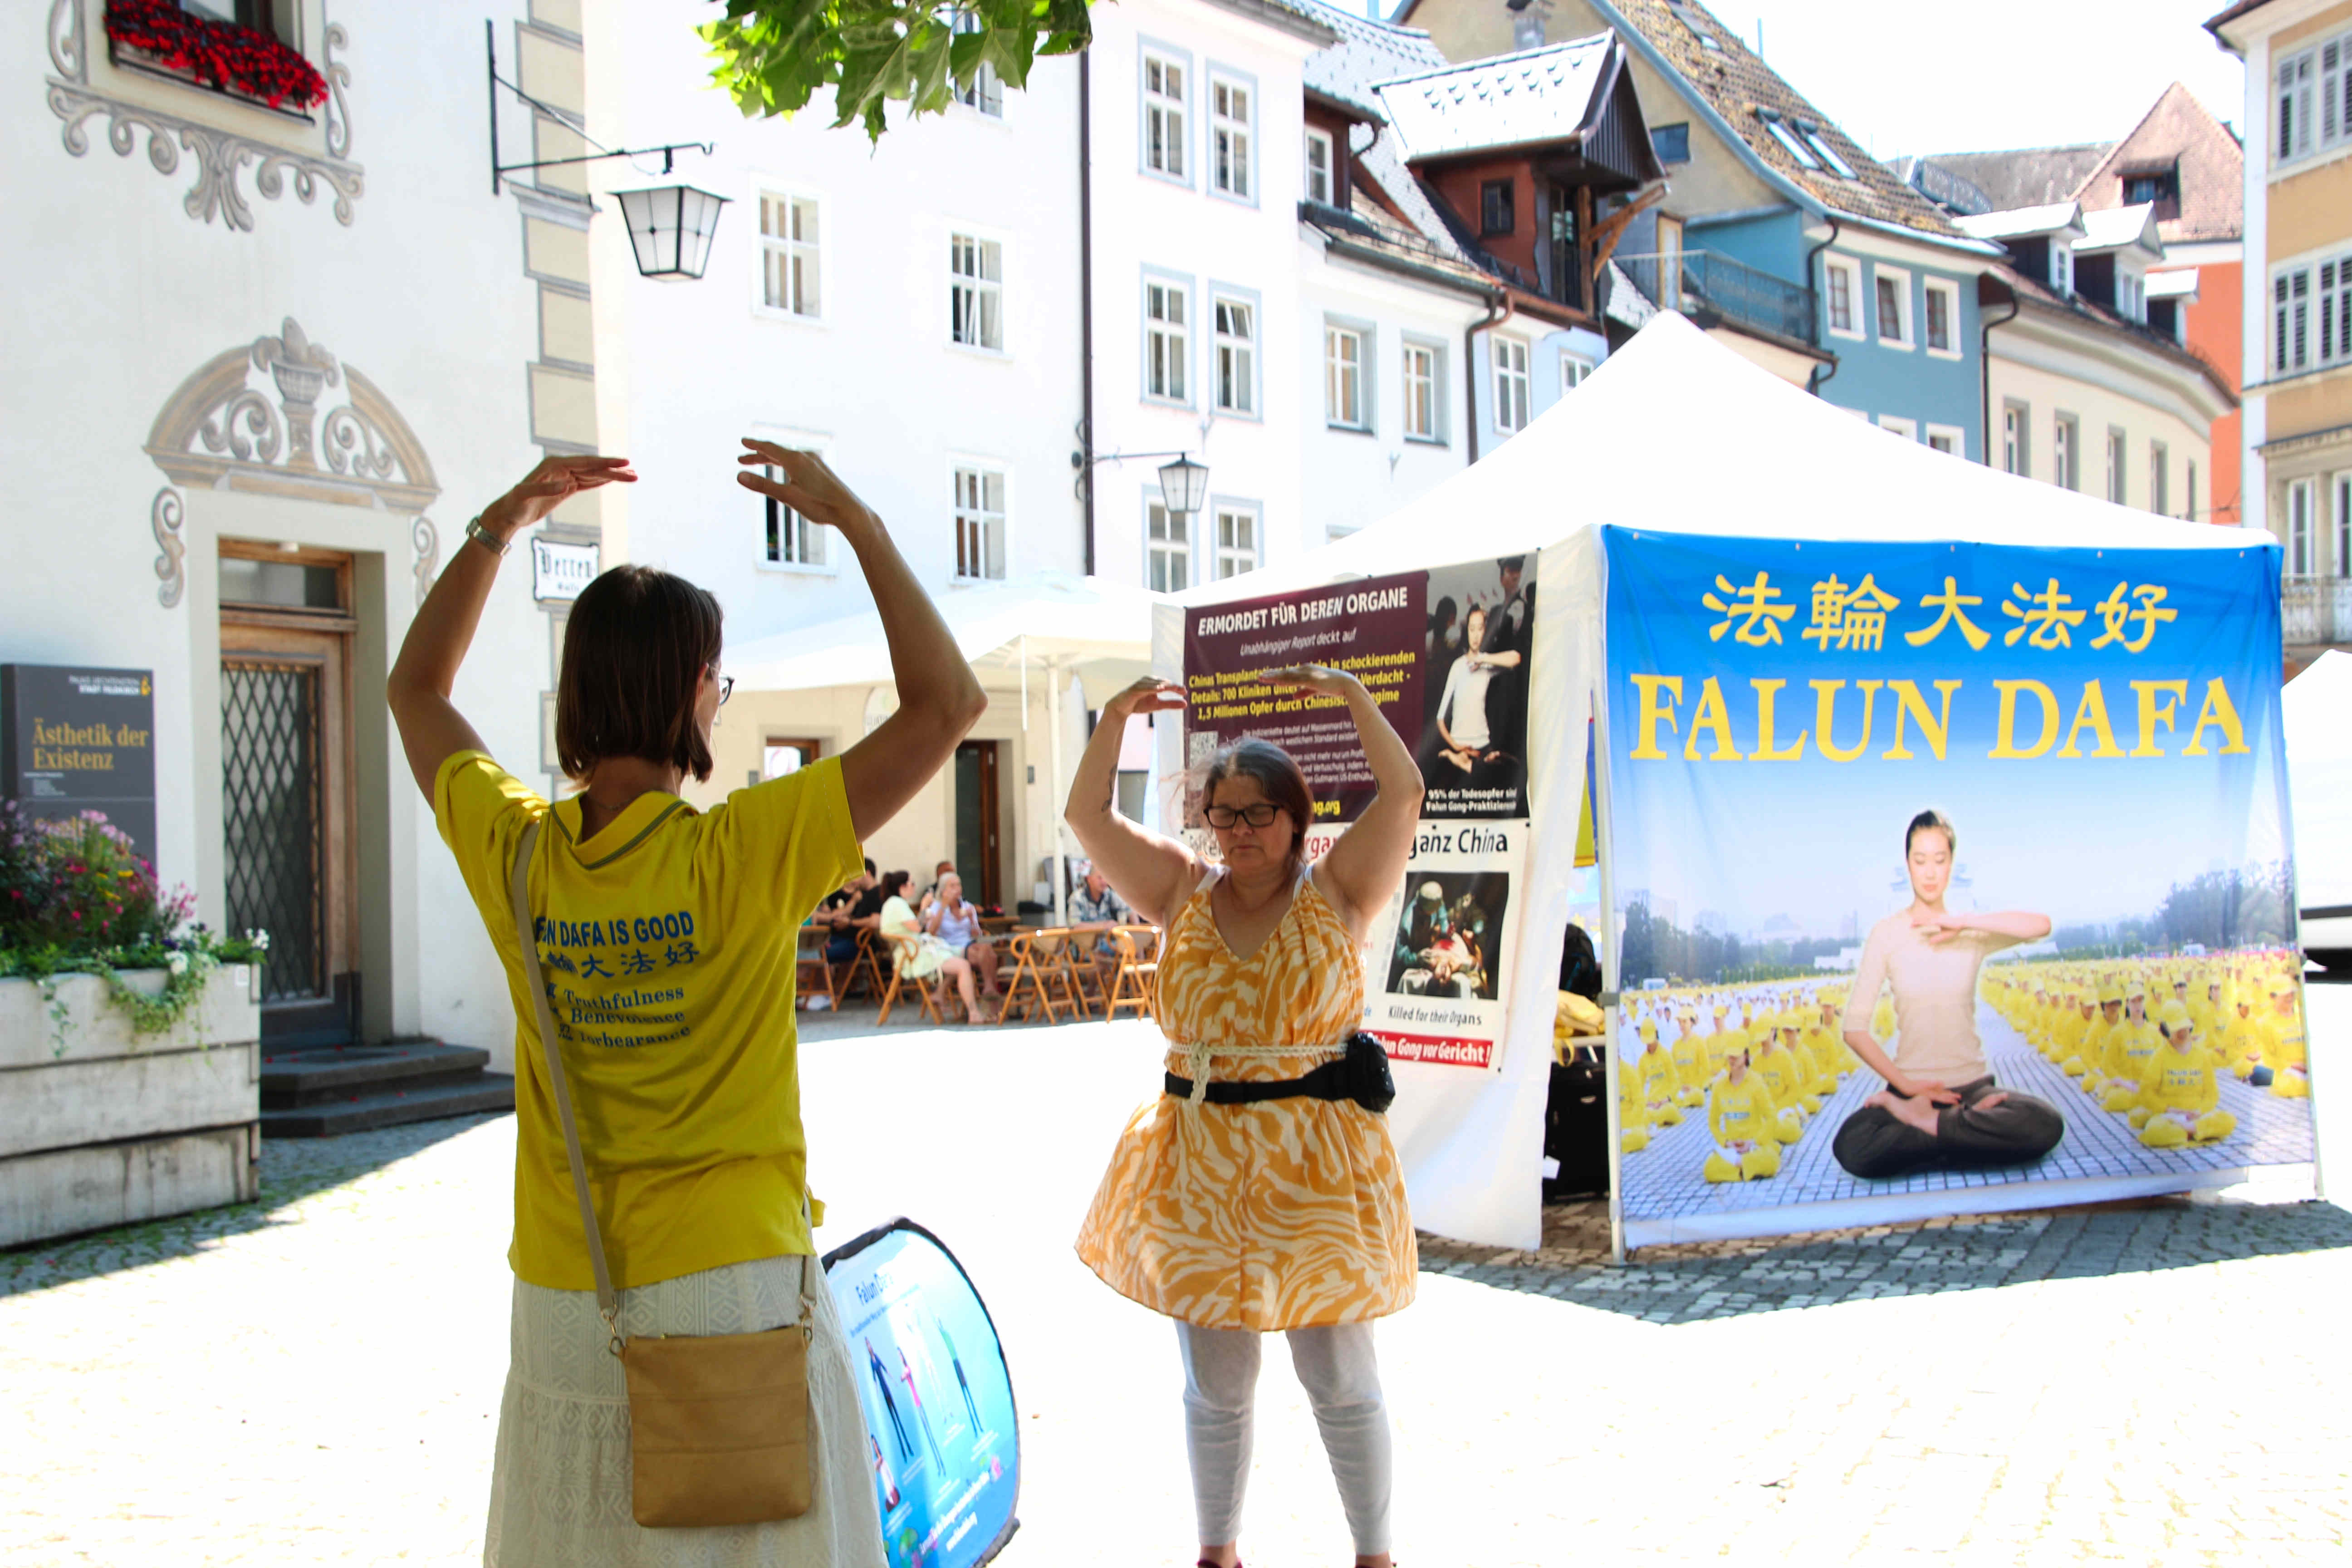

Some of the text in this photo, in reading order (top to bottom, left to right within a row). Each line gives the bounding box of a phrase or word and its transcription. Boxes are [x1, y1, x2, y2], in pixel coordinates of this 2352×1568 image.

[1198, 587, 1407, 636] ERMORDET FÜR DEREN ORGANE
[1702, 571, 2178, 653] 法輪大法好
[1317, 630, 1340, 646] deckt
[1342, 627, 1357, 642] auf
[1341, 650, 1415, 671] schockierenden
[1222, 687, 1237, 701] 700
[1238, 684, 1272, 699] Kliniken
[1213, 704, 1248, 718] Millionen
[1250, 699, 1274, 717] Opfer
[1630, 673, 2251, 761] FALUN DAFA
[32, 717, 149, 748] Ästhetik der
[33, 747, 114, 770] Existenz
[1428, 789, 1447, 800] 95%
[1448, 788, 1460, 799] der
[1461, 787, 1504, 800] Todesopfer
[1426, 800, 1447, 812] Falun
[1458, 827, 1508, 853] China
[559, 921, 606, 947] DAFA
[608, 919, 630, 946] IS
[634, 911, 694, 942] GOOD
[564, 986, 684, 1010] Truthfulness
[1388, 1005, 1414, 1021] Killed
[1415, 1007, 1429, 1022] for
[1430, 1009, 1449, 1023] their
[1449, 1010, 1482, 1027] Organs
[1397, 1038, 1422, 1061] Gong
[1422, 1044, 1438, 1059] vor
[855, 1280, 879, 1307] Falun
